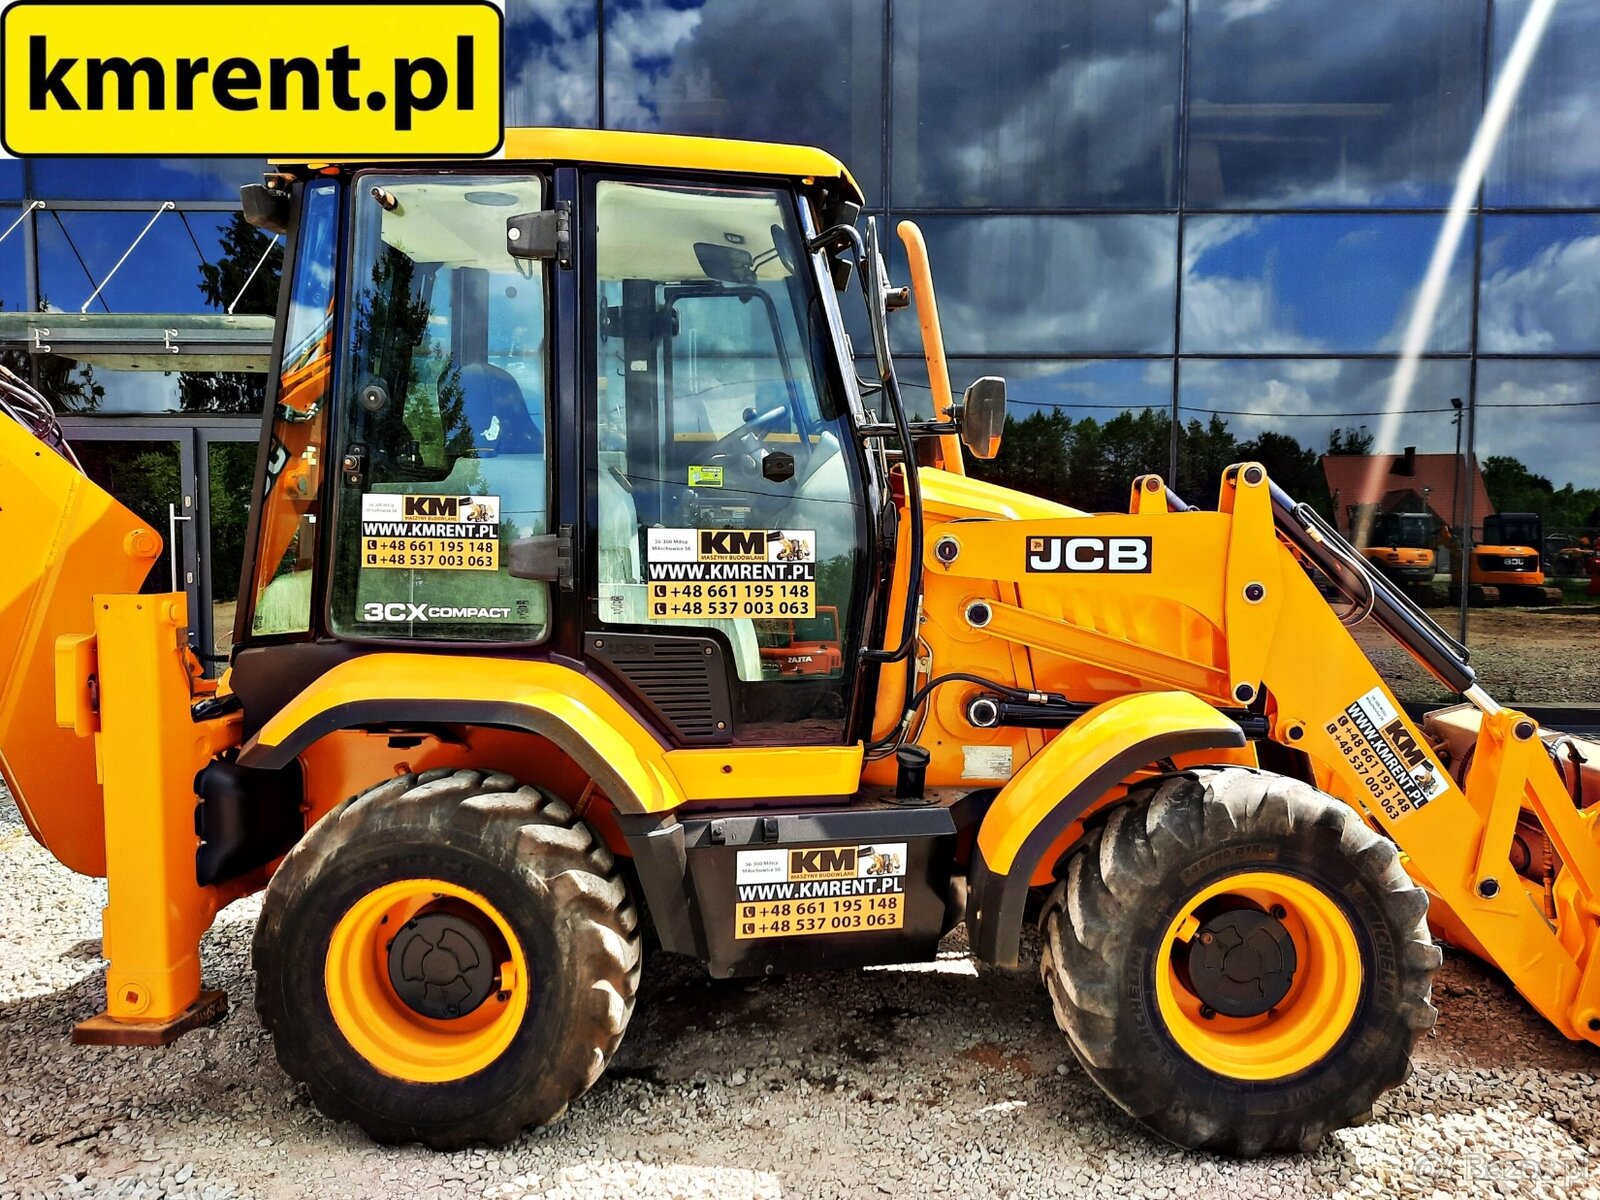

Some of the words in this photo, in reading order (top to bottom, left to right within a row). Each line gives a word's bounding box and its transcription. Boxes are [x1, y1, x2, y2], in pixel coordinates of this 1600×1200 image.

[405, 497, 458, 516] KM
[364, 523, 497, 538] WWW.KMRENT.PL
[380, 540, 405, 550] +48
[410, 541, 434, 552] 661
[440, 542, 464, 552] 195
[469, 542, 493, 552] 148
[701, 532, 764, 554] KM
[380, 554, 405, 564] +48
[410, 555, 434, 565] 537
[440, 556, 464, 566] 003
[468, 556, 492, 566] 063
[1030, 538, 1147, 570] JCB
[650, 564, 814, 580] WWW.KMRENT.PL
[671, 585, 702, 598] +48
[708, 585, 737, 598] 661
[744, 585, 774, 598] 195
[780, 585, 809, 598] 148
[364, 603, 428, 621] 3CX
[428, 608, 511, 618] COMPACT
[671, 602, 702, 614] +48
[708, 602, 738, 614] 537
[744, 602, 774, 614] 003
[780, 602, 808, 614] 063
[608, 644, 650, 655] JCB
[1385, 719, 1426, 766] KM
[1348, 704, 1425, 808] WWW.KMRENT.PL
[1335, 734, 1353, 755] +48
[1349, 756, 1369, 775] 537
[1365, 777, 1384, 798] 003
[1381, 799, 1399, 819] 063
[1346, 727, 1364, 747] +48
[1361, 748, 1378, 768] 661
[1377, 770, 1395, 790] 195
[1392, 791, 1410, 812] 148
[792, 849, 856, 874] KM
[739, 878, 902, 901] WWW.KMRENT.PL
[760, 904, 790, 917] +48
[796, 902, 825, 915] 661
[834, 900, 862, 912] 195
[869, 898, 897, 910] 148
[759, 921, 790, 933] +48
[796, 918, 826, 930] 537
[832, 916, 861, 929] 003
[867, 914, 896, 926] 063
